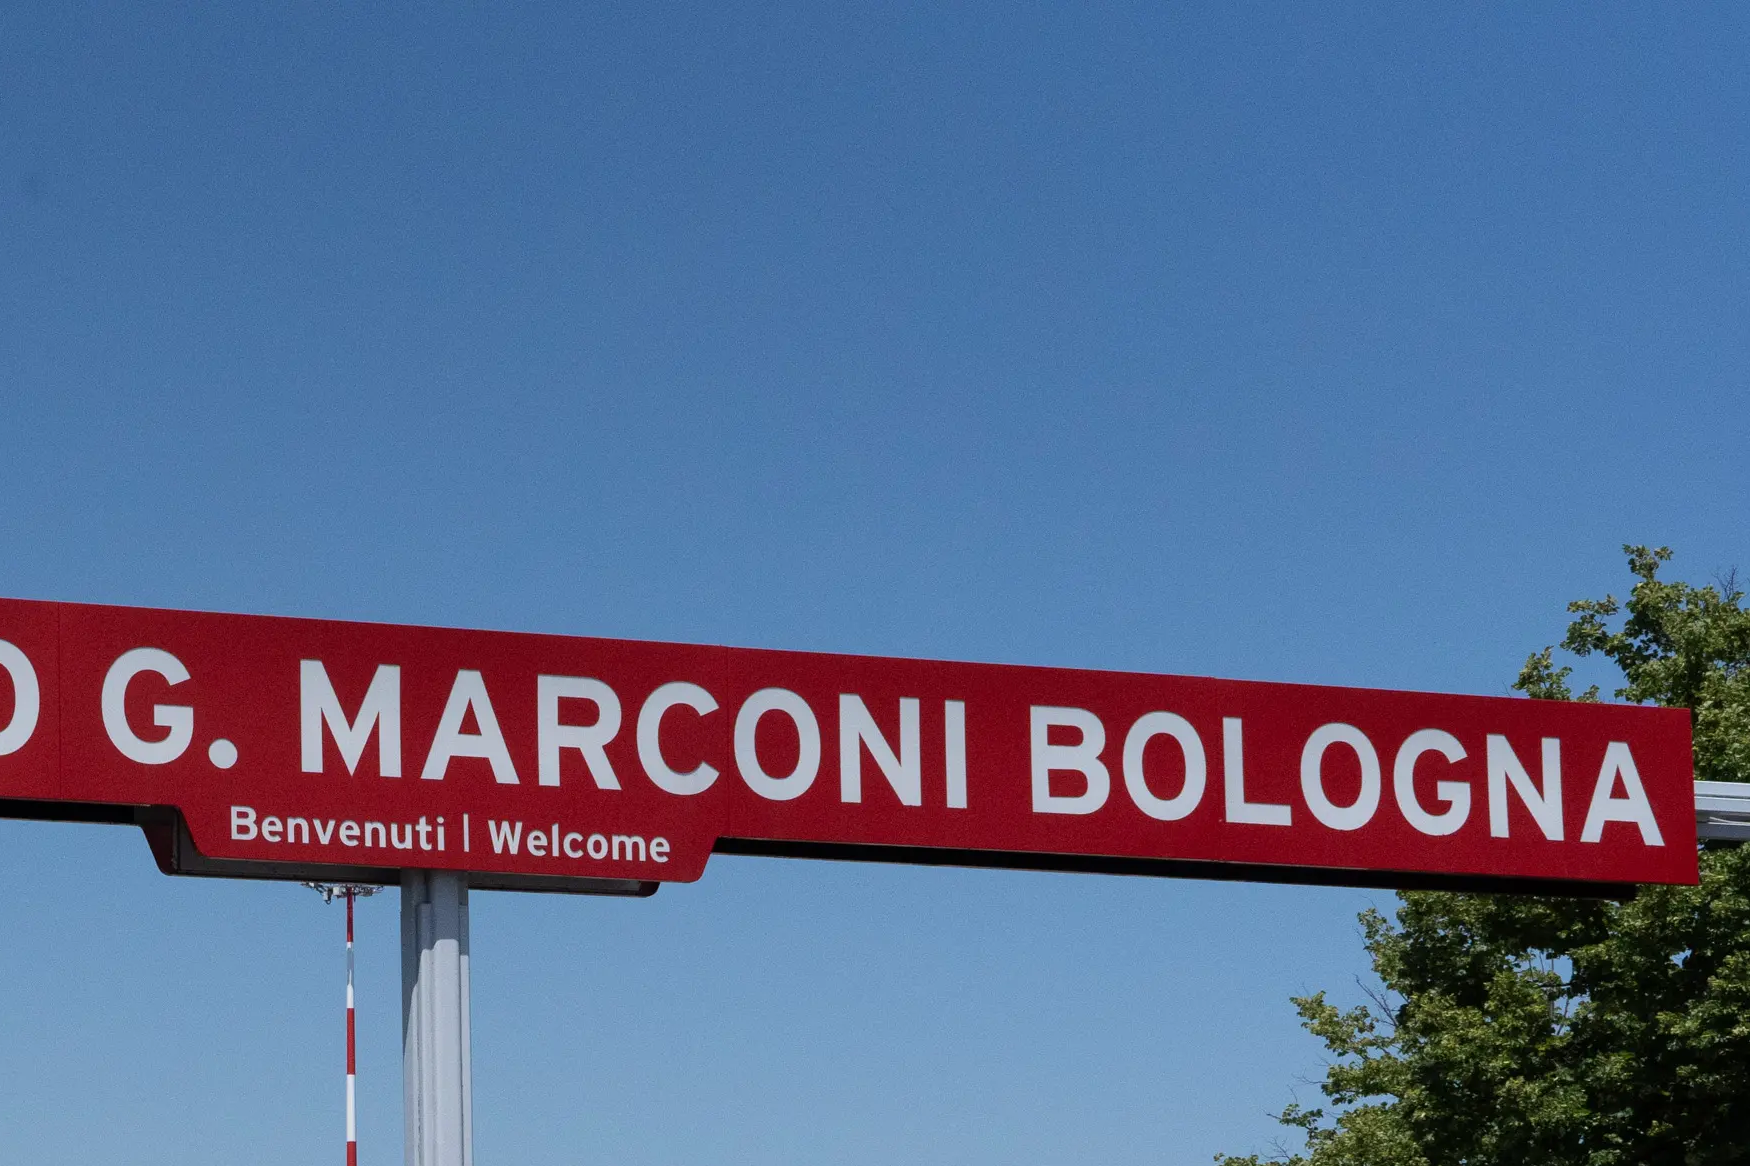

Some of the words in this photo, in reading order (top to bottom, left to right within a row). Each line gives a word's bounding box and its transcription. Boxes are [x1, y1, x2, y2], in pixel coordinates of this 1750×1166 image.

[102, 648, 237, 768] G.
[301, 660, 967, 808] MARCONI
[1030, 706, 1665, 847] BOLOGNA
[230, 805, 445, 851] Benvenuti
[487, 820, 671, 863] Welcome
